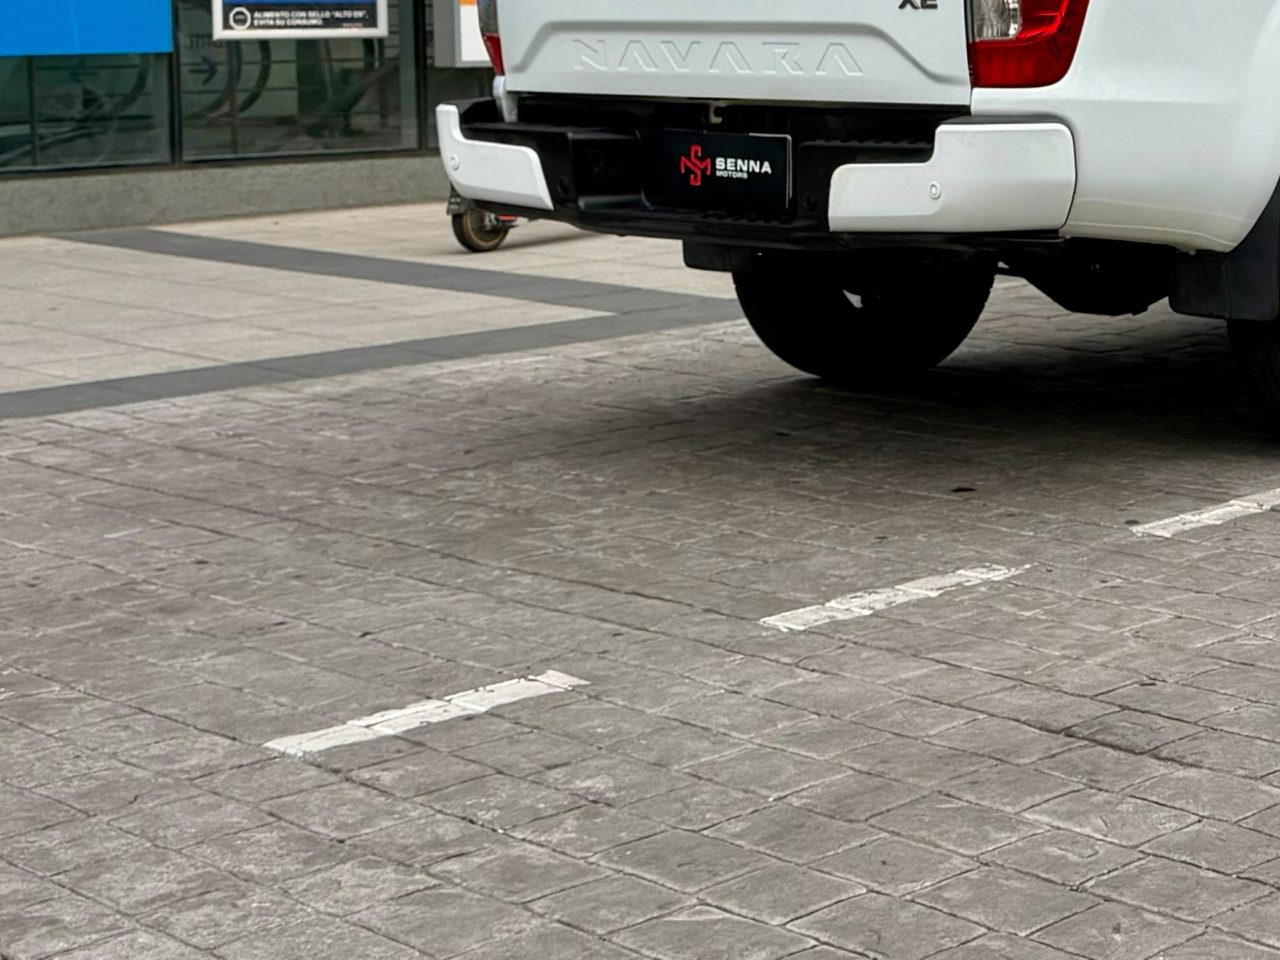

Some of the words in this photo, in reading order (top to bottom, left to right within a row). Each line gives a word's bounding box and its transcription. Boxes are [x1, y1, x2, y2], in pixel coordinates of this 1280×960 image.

[572, 38, 863, 76] NAVARA
[715, 157, 772, 174] SENNA
[716, 170, 748, 179] MOTORS
